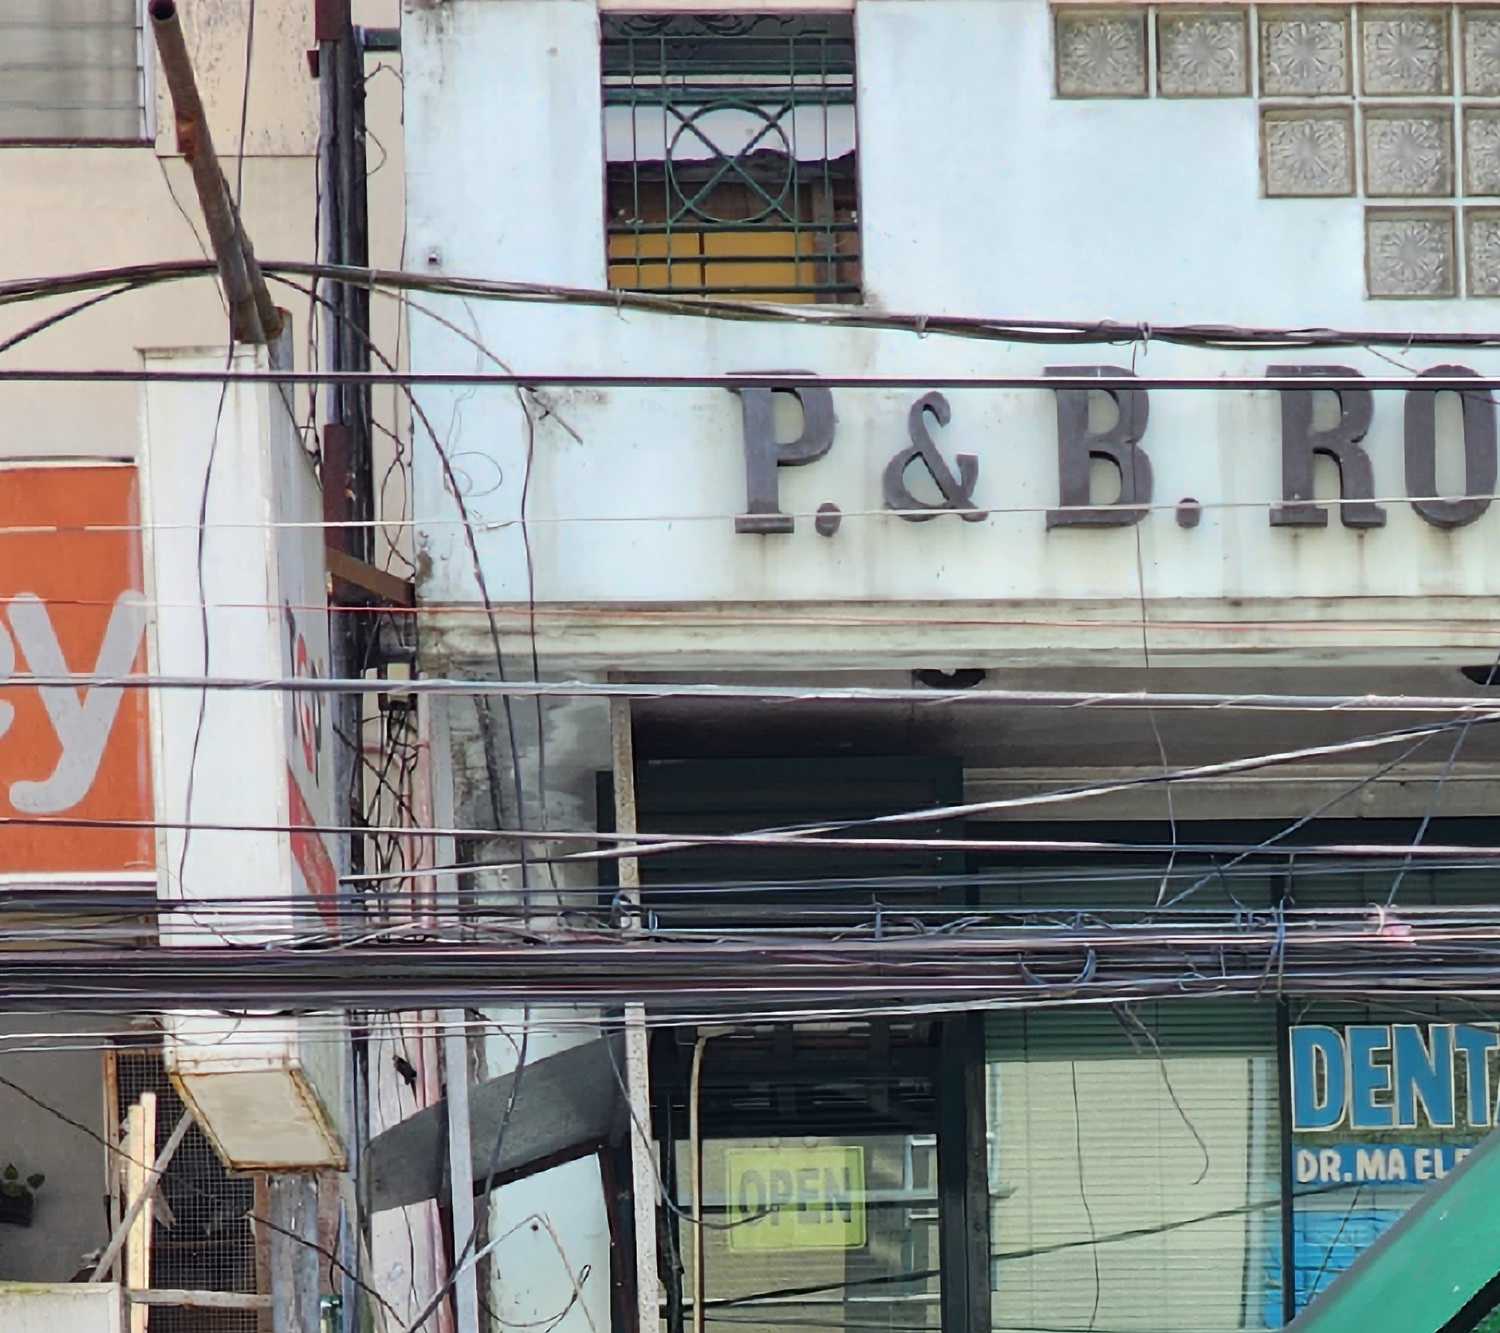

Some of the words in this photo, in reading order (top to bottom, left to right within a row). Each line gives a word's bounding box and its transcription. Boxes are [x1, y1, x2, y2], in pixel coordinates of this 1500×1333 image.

[730, 369, 841, 537] P.
[881, 389, 990, 524] &
[1043, 364, 1203, 532] B.
[0, 589, 148, 813] y
[738, 1166, 853, 1228] OPEN
